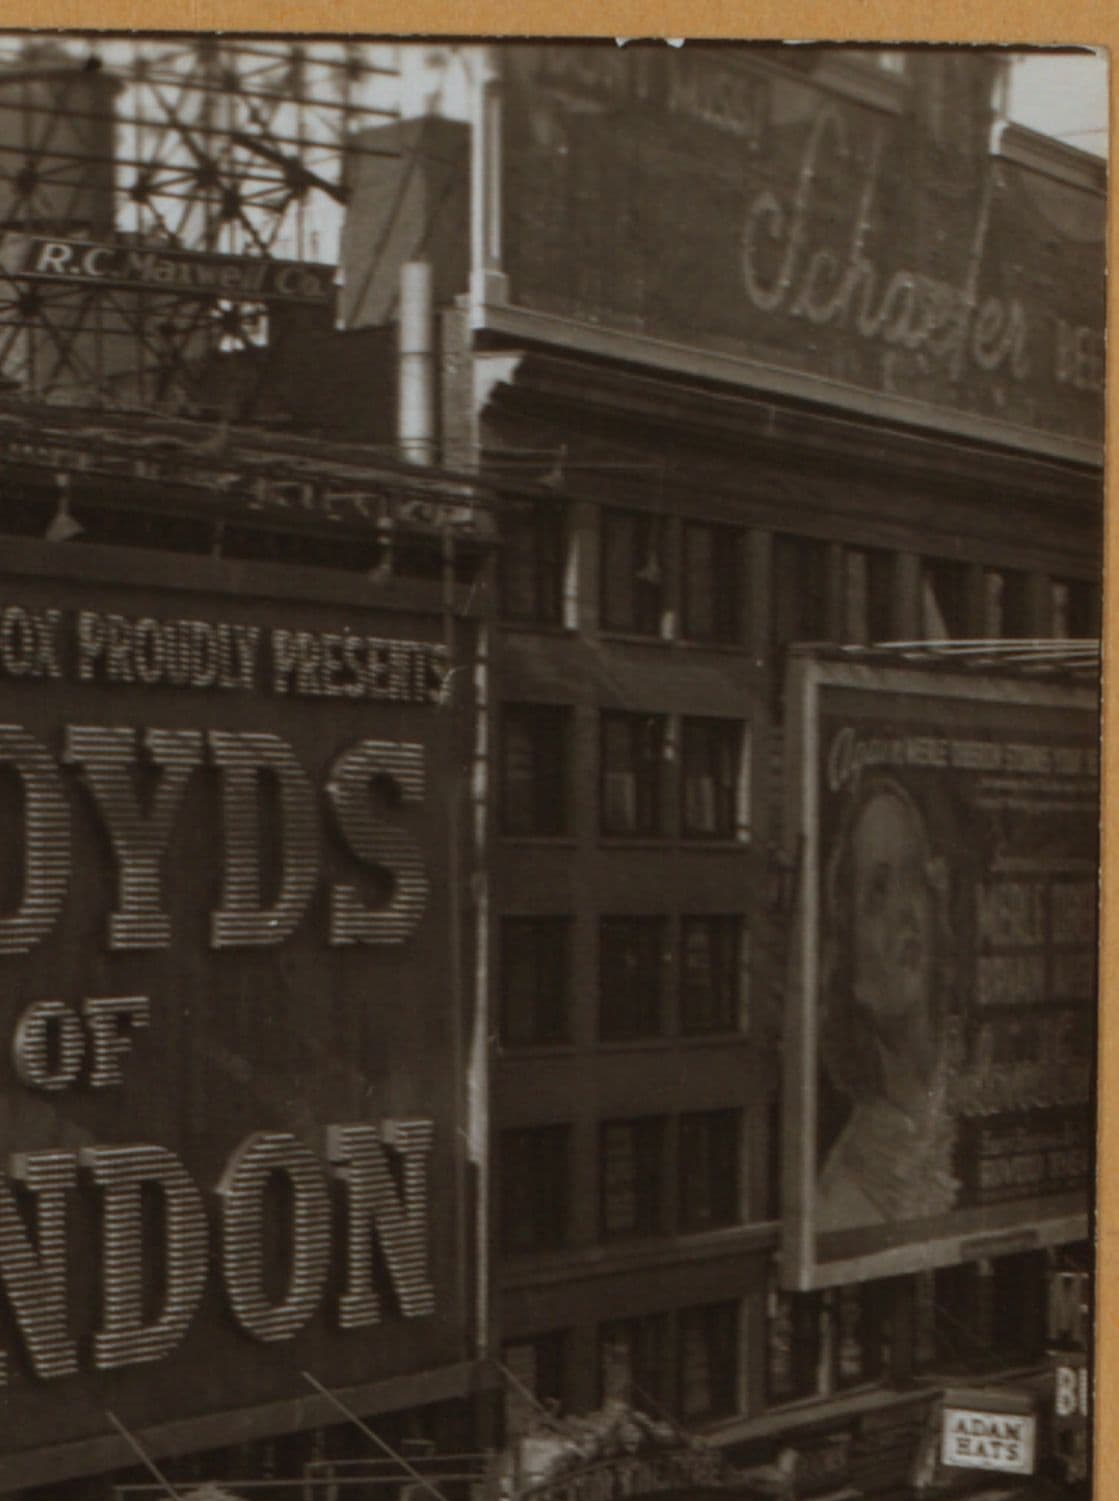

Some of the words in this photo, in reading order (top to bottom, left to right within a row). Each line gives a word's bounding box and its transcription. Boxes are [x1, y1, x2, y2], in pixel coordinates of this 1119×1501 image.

[76, 609, 262, 694] PROUDLY
[271, 624, 457, 709] PRESENTS
[12, 994, 151, 1093] OF
